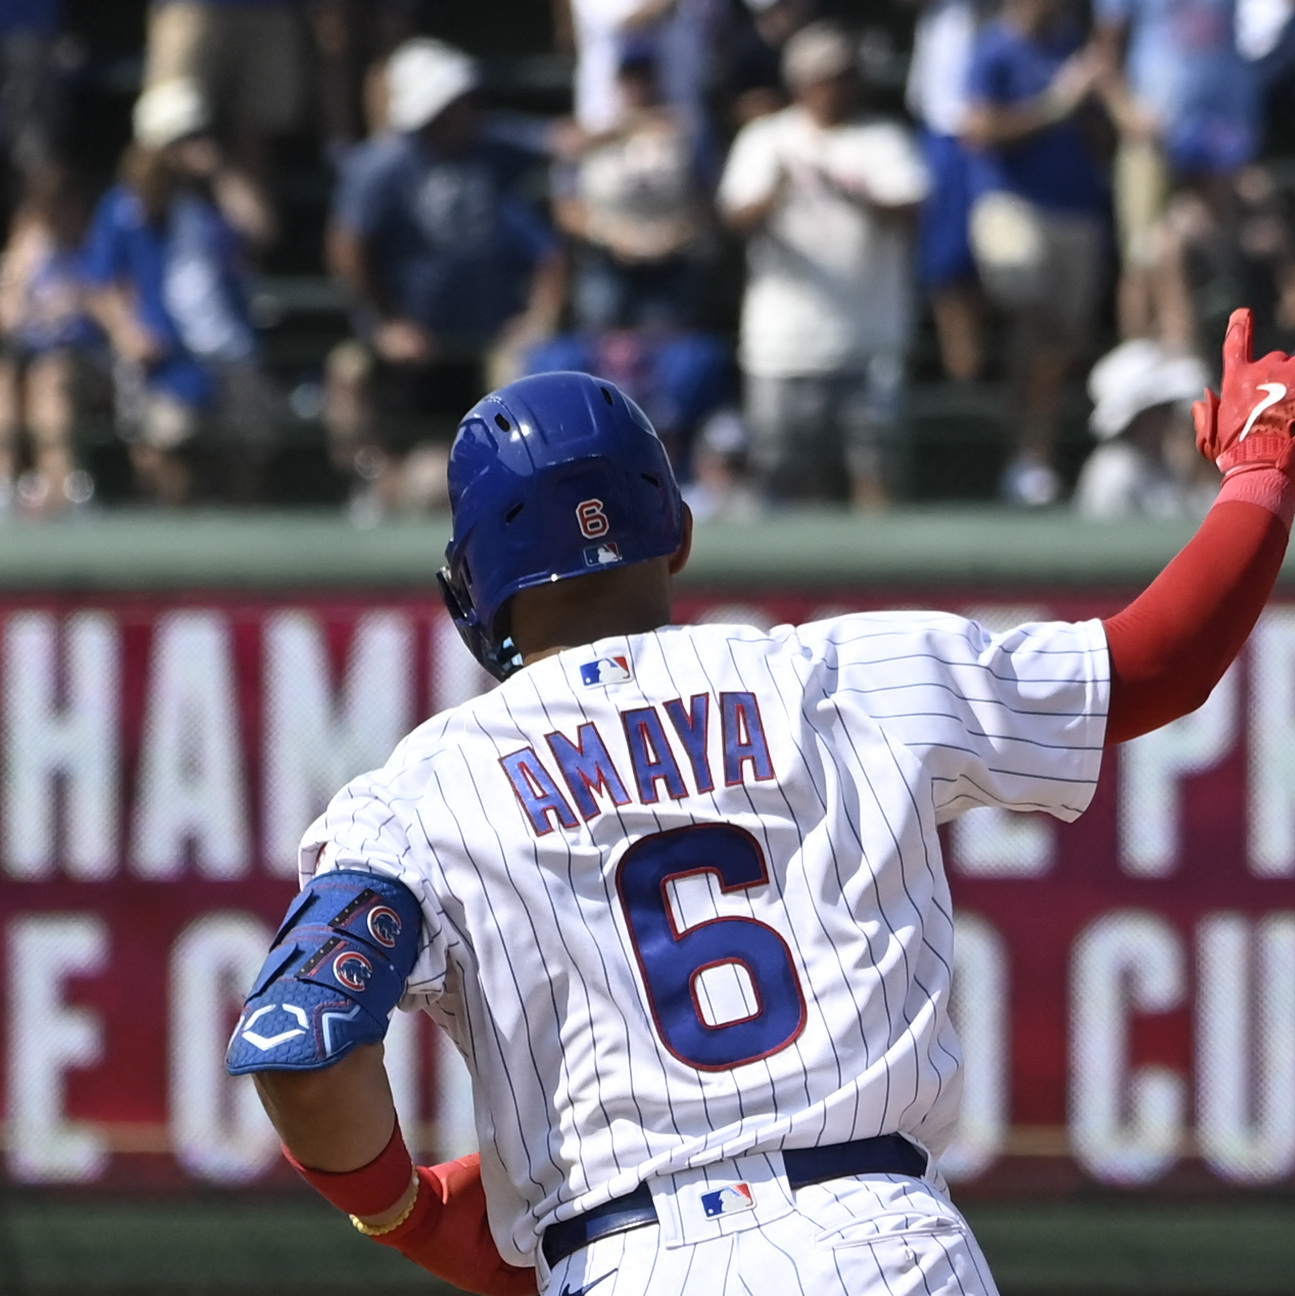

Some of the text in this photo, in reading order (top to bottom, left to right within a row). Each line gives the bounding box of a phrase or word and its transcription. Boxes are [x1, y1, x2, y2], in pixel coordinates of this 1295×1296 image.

[576, 498, 610, 539] 6
[498, 691, 777, 837] AMAYA
[615, 821, 807, 1073] 6
